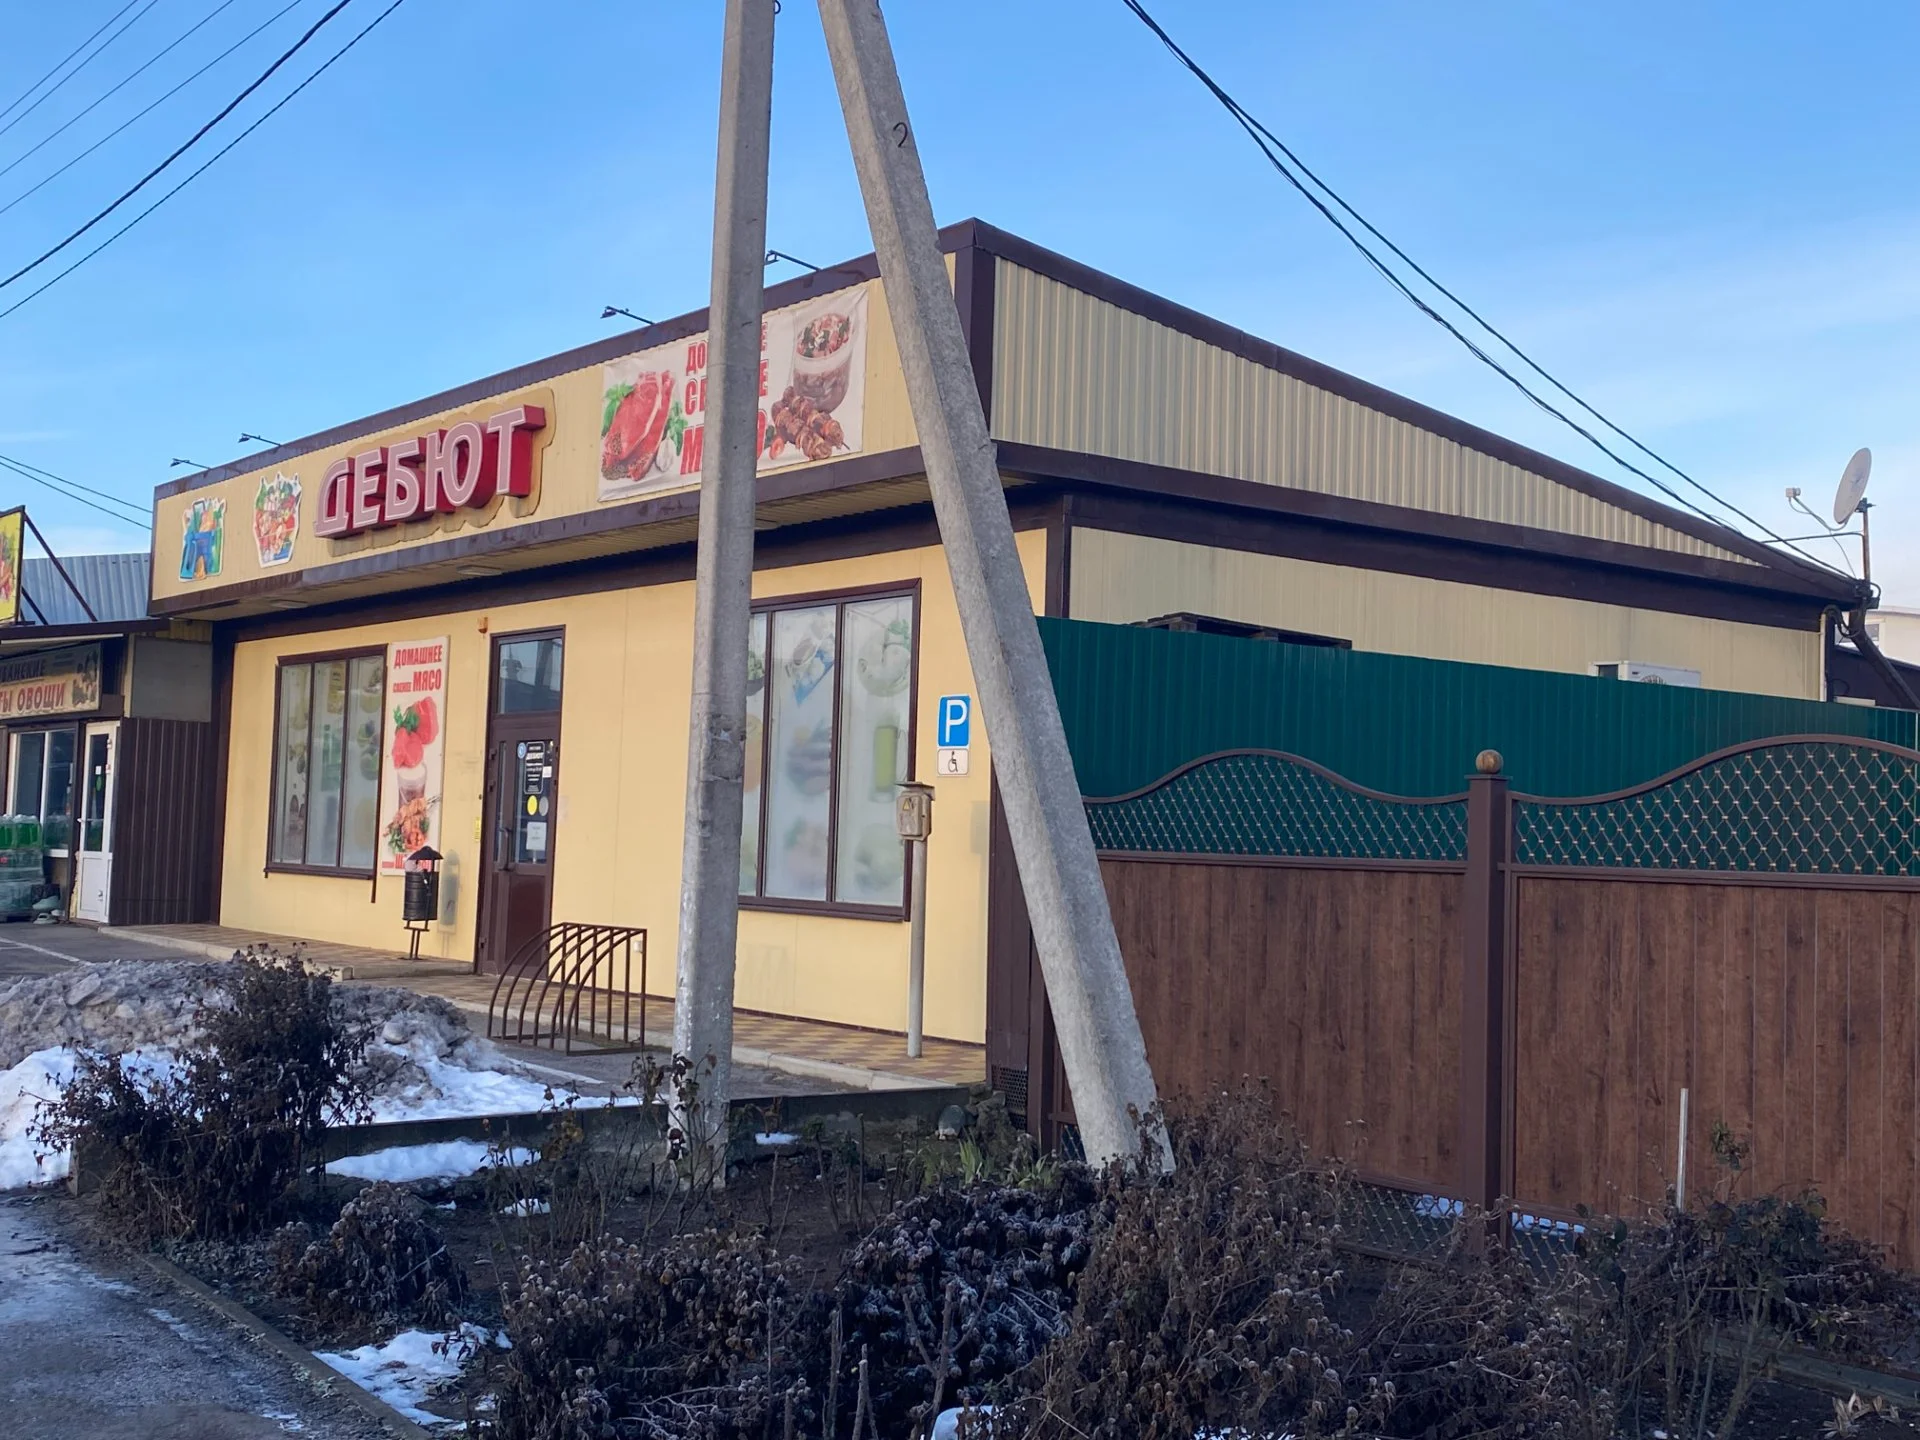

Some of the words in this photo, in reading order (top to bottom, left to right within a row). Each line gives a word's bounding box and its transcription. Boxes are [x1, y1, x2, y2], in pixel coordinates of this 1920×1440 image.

[313, 404, 546, 539] ДЕБЮТ
[394, 644, 443, 669] ДОМАШНЕЕ
[412, 668, 442, 692] МЯСО
[17, 682, 66, 712] ОВОЩИ
